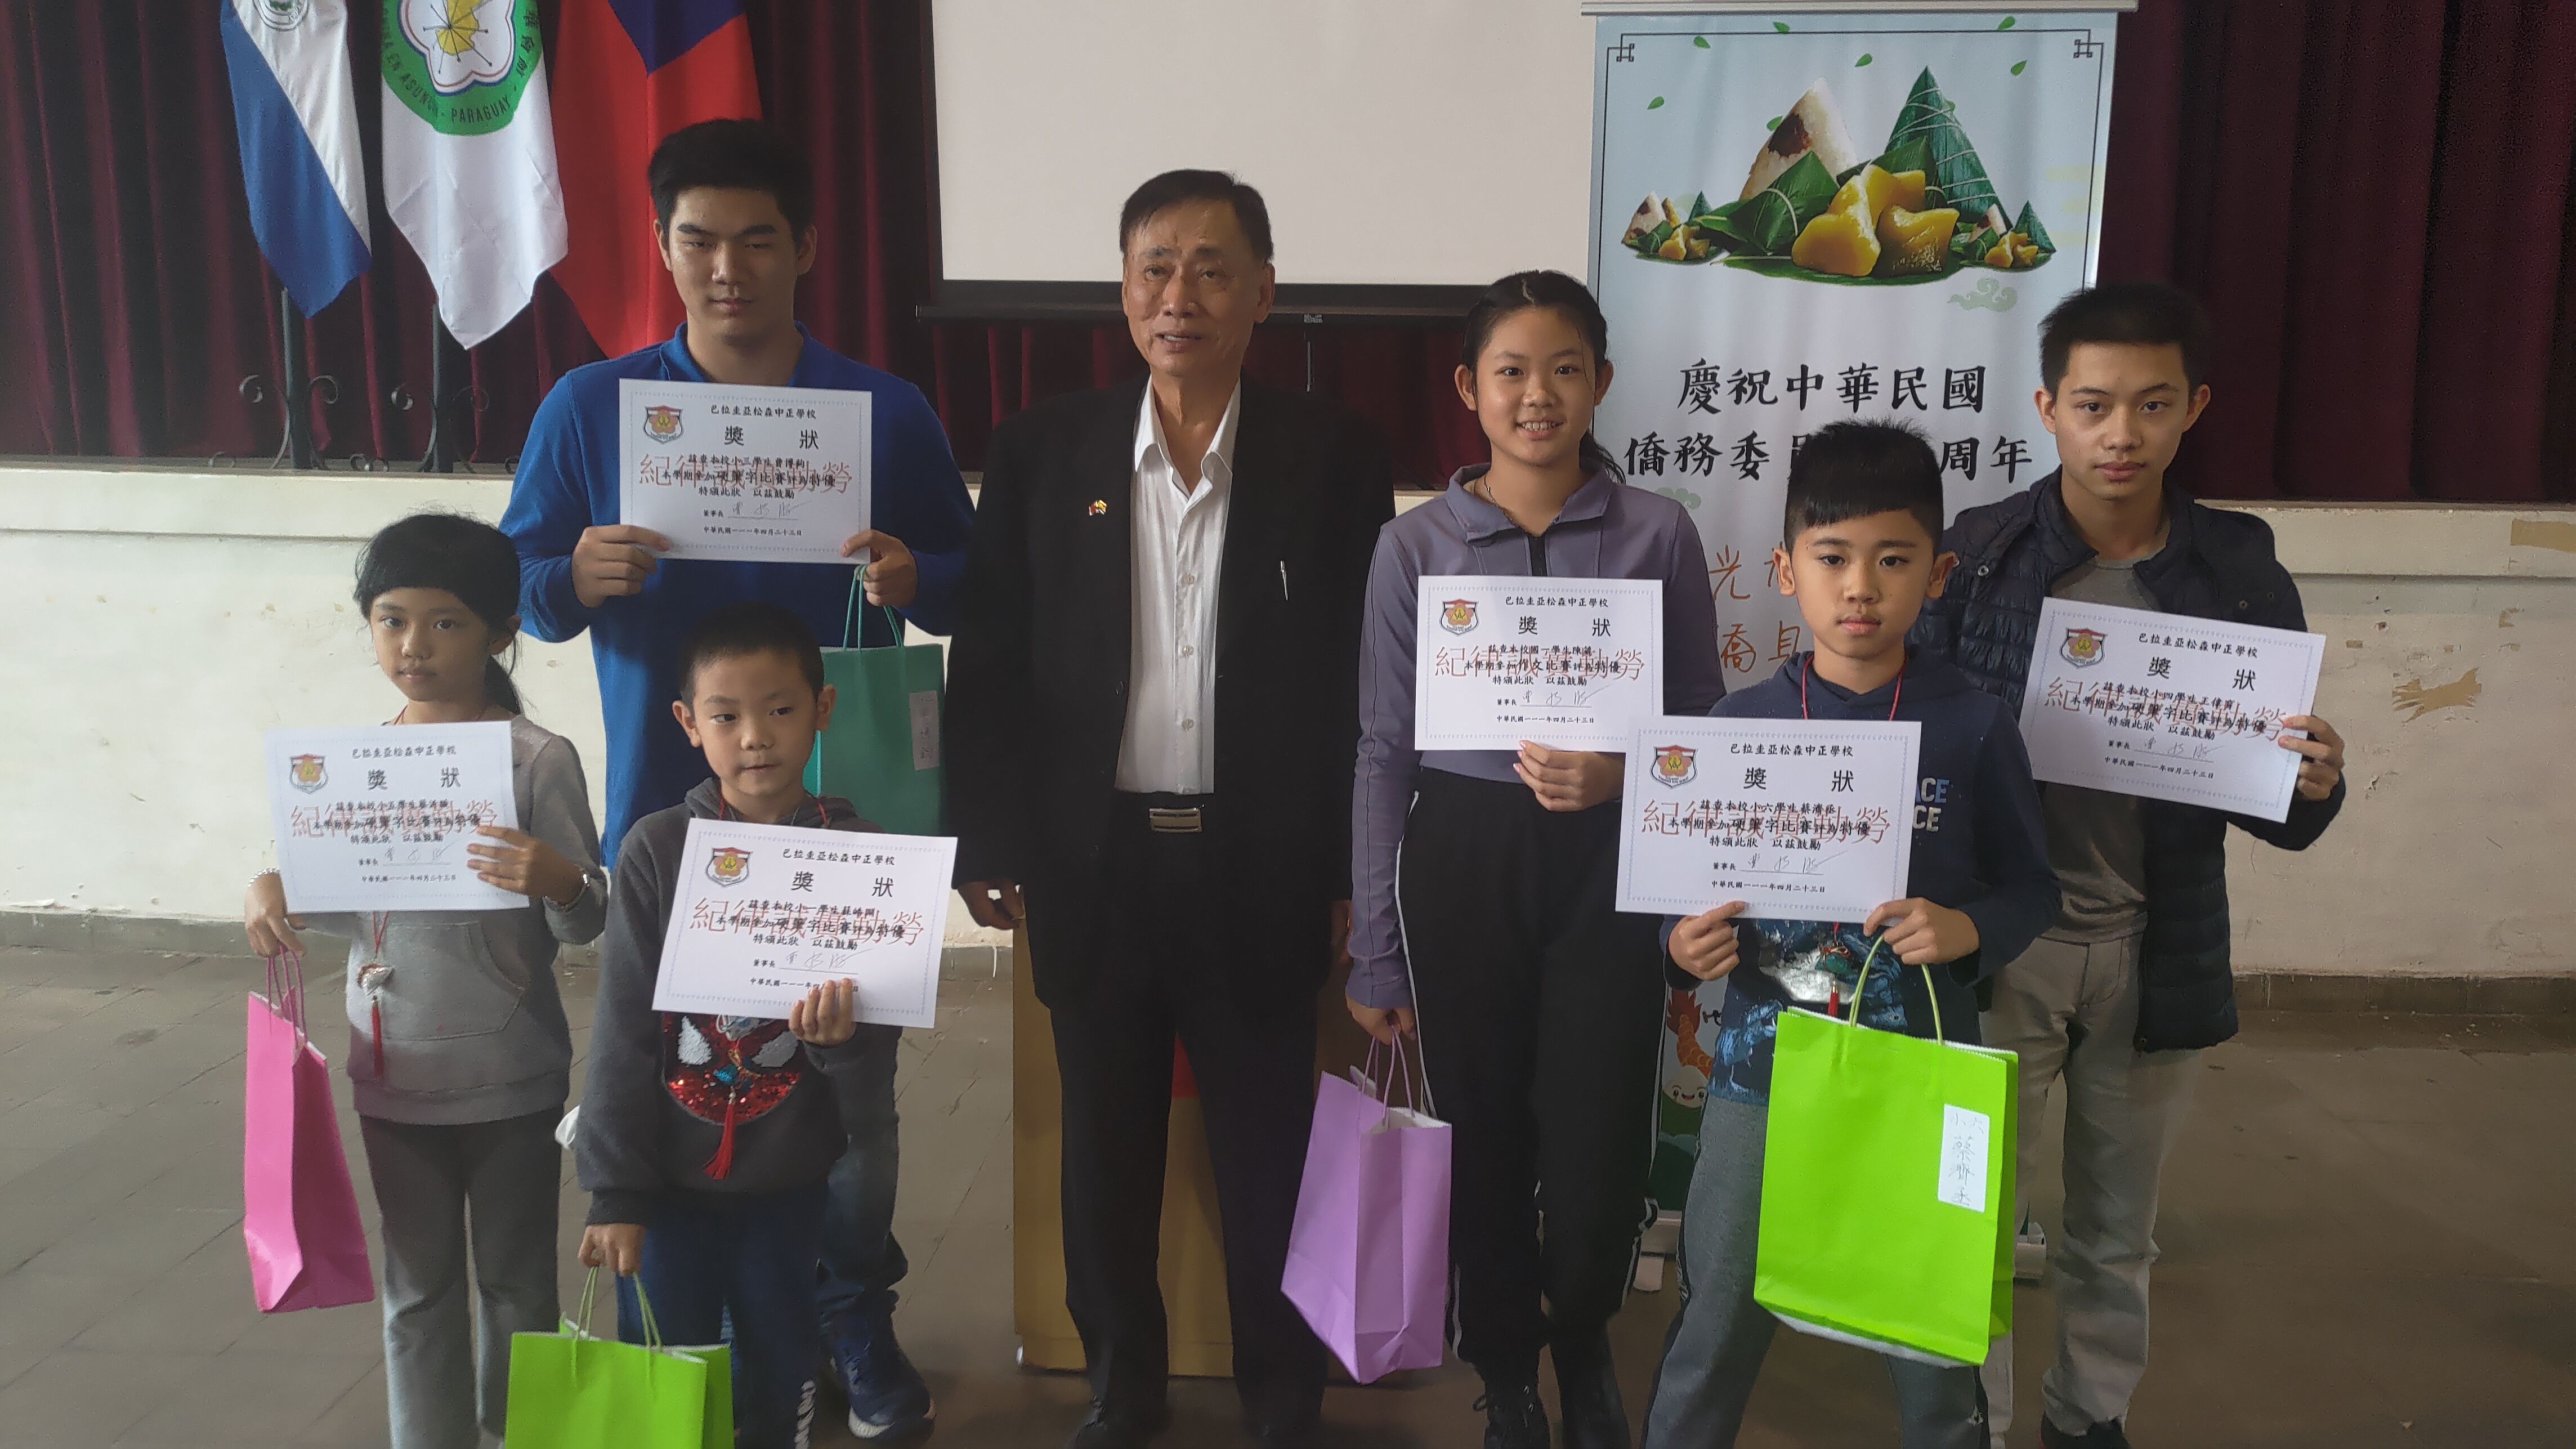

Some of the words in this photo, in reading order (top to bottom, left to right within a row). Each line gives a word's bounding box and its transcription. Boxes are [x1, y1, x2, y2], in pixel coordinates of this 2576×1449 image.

[451, 94, 511, 124] PARAGUAY
[1678, 357, 1987, 415] 慶祝中華民國
[1506, 597, 1608, 608] 巴拉圭亞松森中正學校
[1519, 616, 1537, 635] 獎
[1592, 618, 1611, 637] 狀
[1730, 744, 1854, 757] 巴拉圭亞松森中正學校
[1745, 768, 1766, 789] 獎
[1831, 770, 1854, 792] 狀
